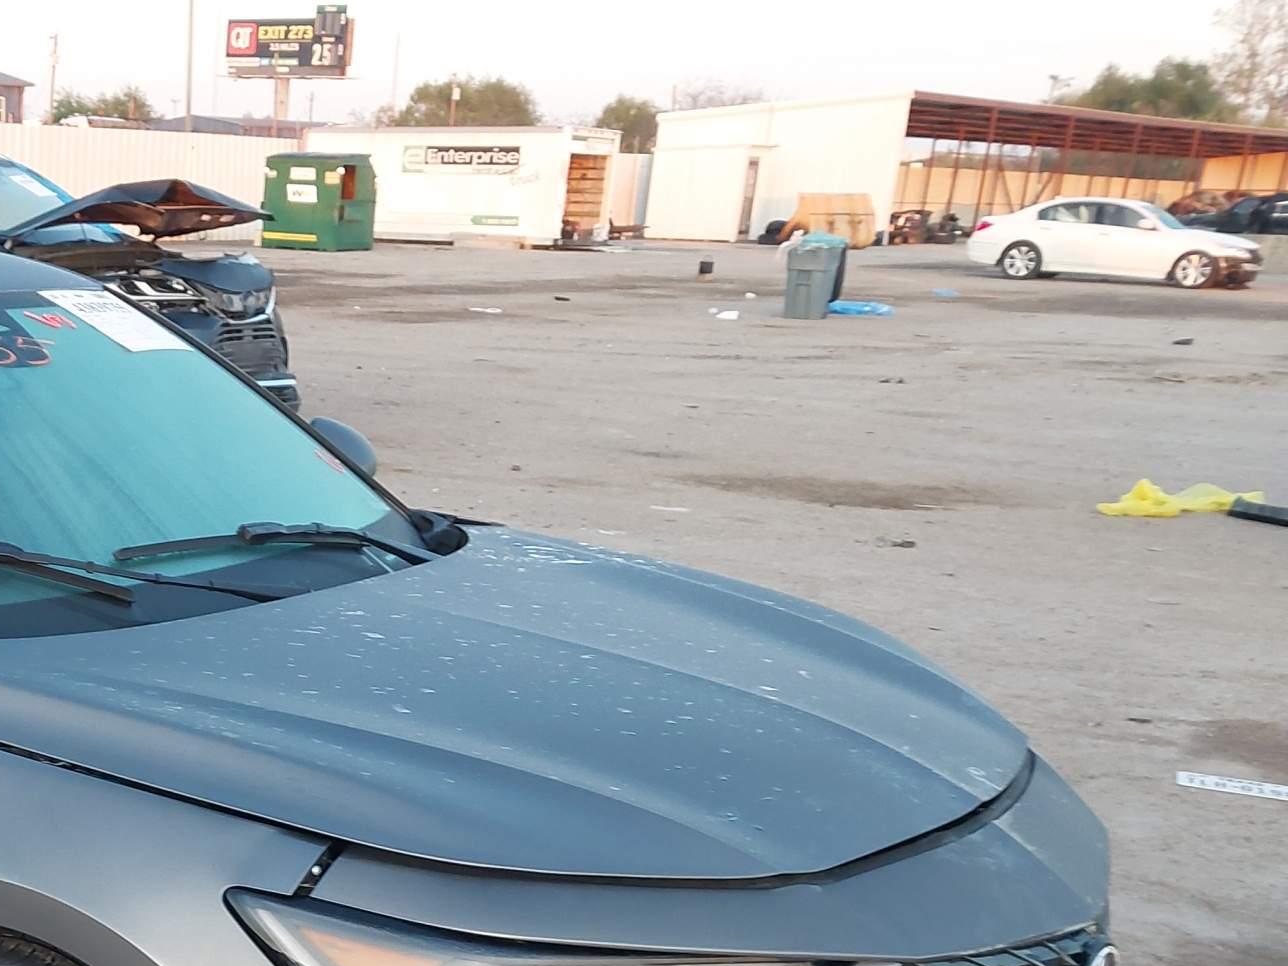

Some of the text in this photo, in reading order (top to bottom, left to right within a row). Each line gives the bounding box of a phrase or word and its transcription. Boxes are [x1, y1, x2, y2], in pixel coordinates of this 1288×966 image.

[258, 26, 287, 39] EXIT
[288, 25, 313, 39] 273
[425, 147, 520, 169] Enterprise
